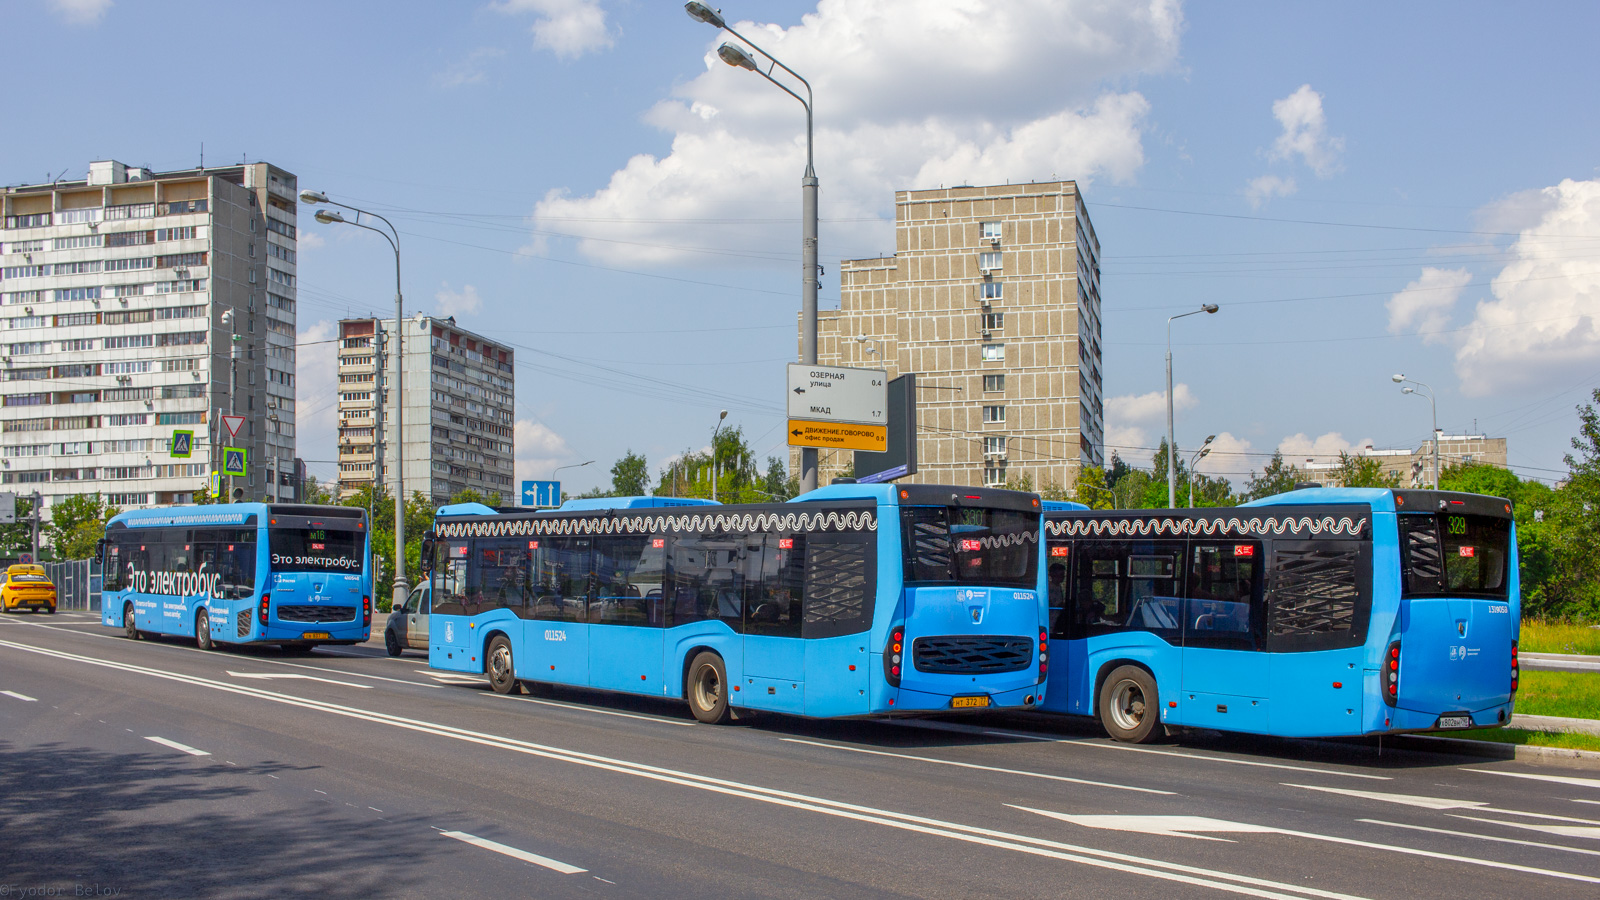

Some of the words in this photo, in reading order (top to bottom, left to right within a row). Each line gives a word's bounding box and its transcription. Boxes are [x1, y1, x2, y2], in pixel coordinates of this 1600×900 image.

[810, 371, 845, 380] ОЗЕРНАЯ
[810, 406, 831, 414] МКАД
[962, 509, 983, 526] 330
[1448, 516, 1466, 535] 329
[271, 553, 293, 564] Это
[295, 556, 360, 569] электробус.
[126, 561, 147, 593] Это
[149, 561, 224, 606] электробус.
[1013, 592, 1034, 600] 011524
[544, 630, 566, 641] 011524
[966, 698, 977, 706] 372
